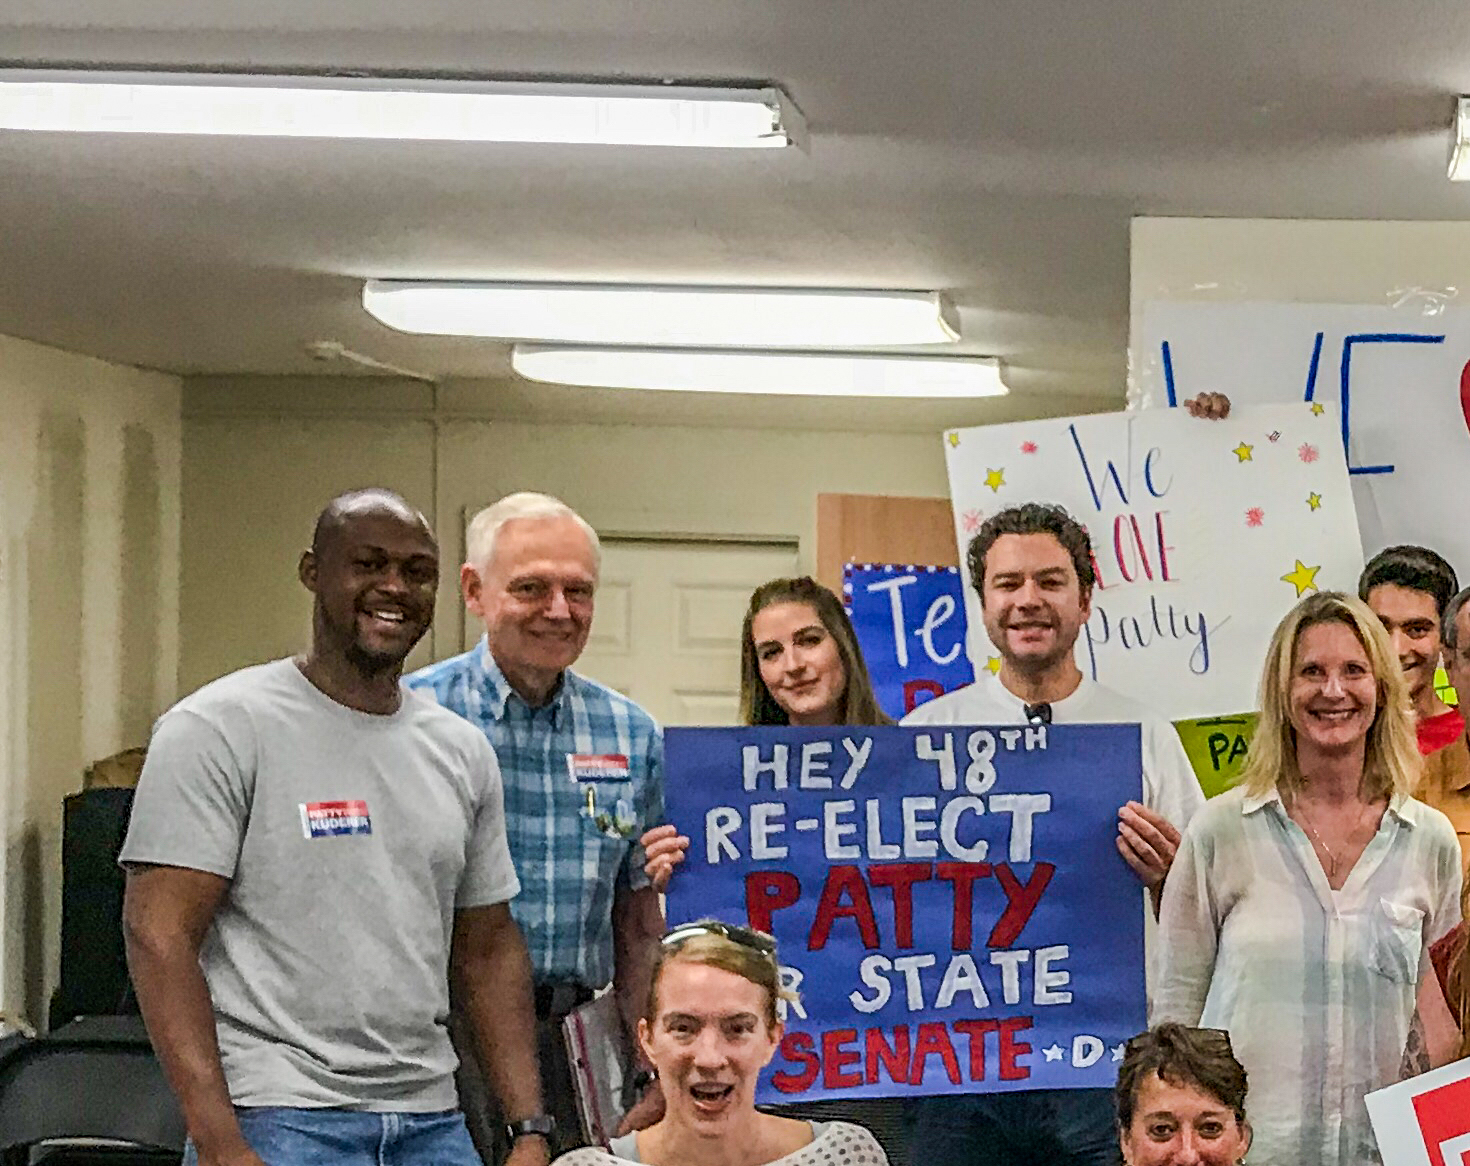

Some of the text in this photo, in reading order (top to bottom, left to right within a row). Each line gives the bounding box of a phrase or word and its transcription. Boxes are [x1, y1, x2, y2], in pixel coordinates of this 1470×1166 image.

[1065, 416, 1174, 511] We
[741, 727, 1048, 796] HEY 48TH
[705, 792, 1052, 865] RE-ELECT
[744, 862, 1056, 952] PATTY
[849, 944, 1072, 1013] STATE
[771, 1016, 1035, 1093] SENATE
